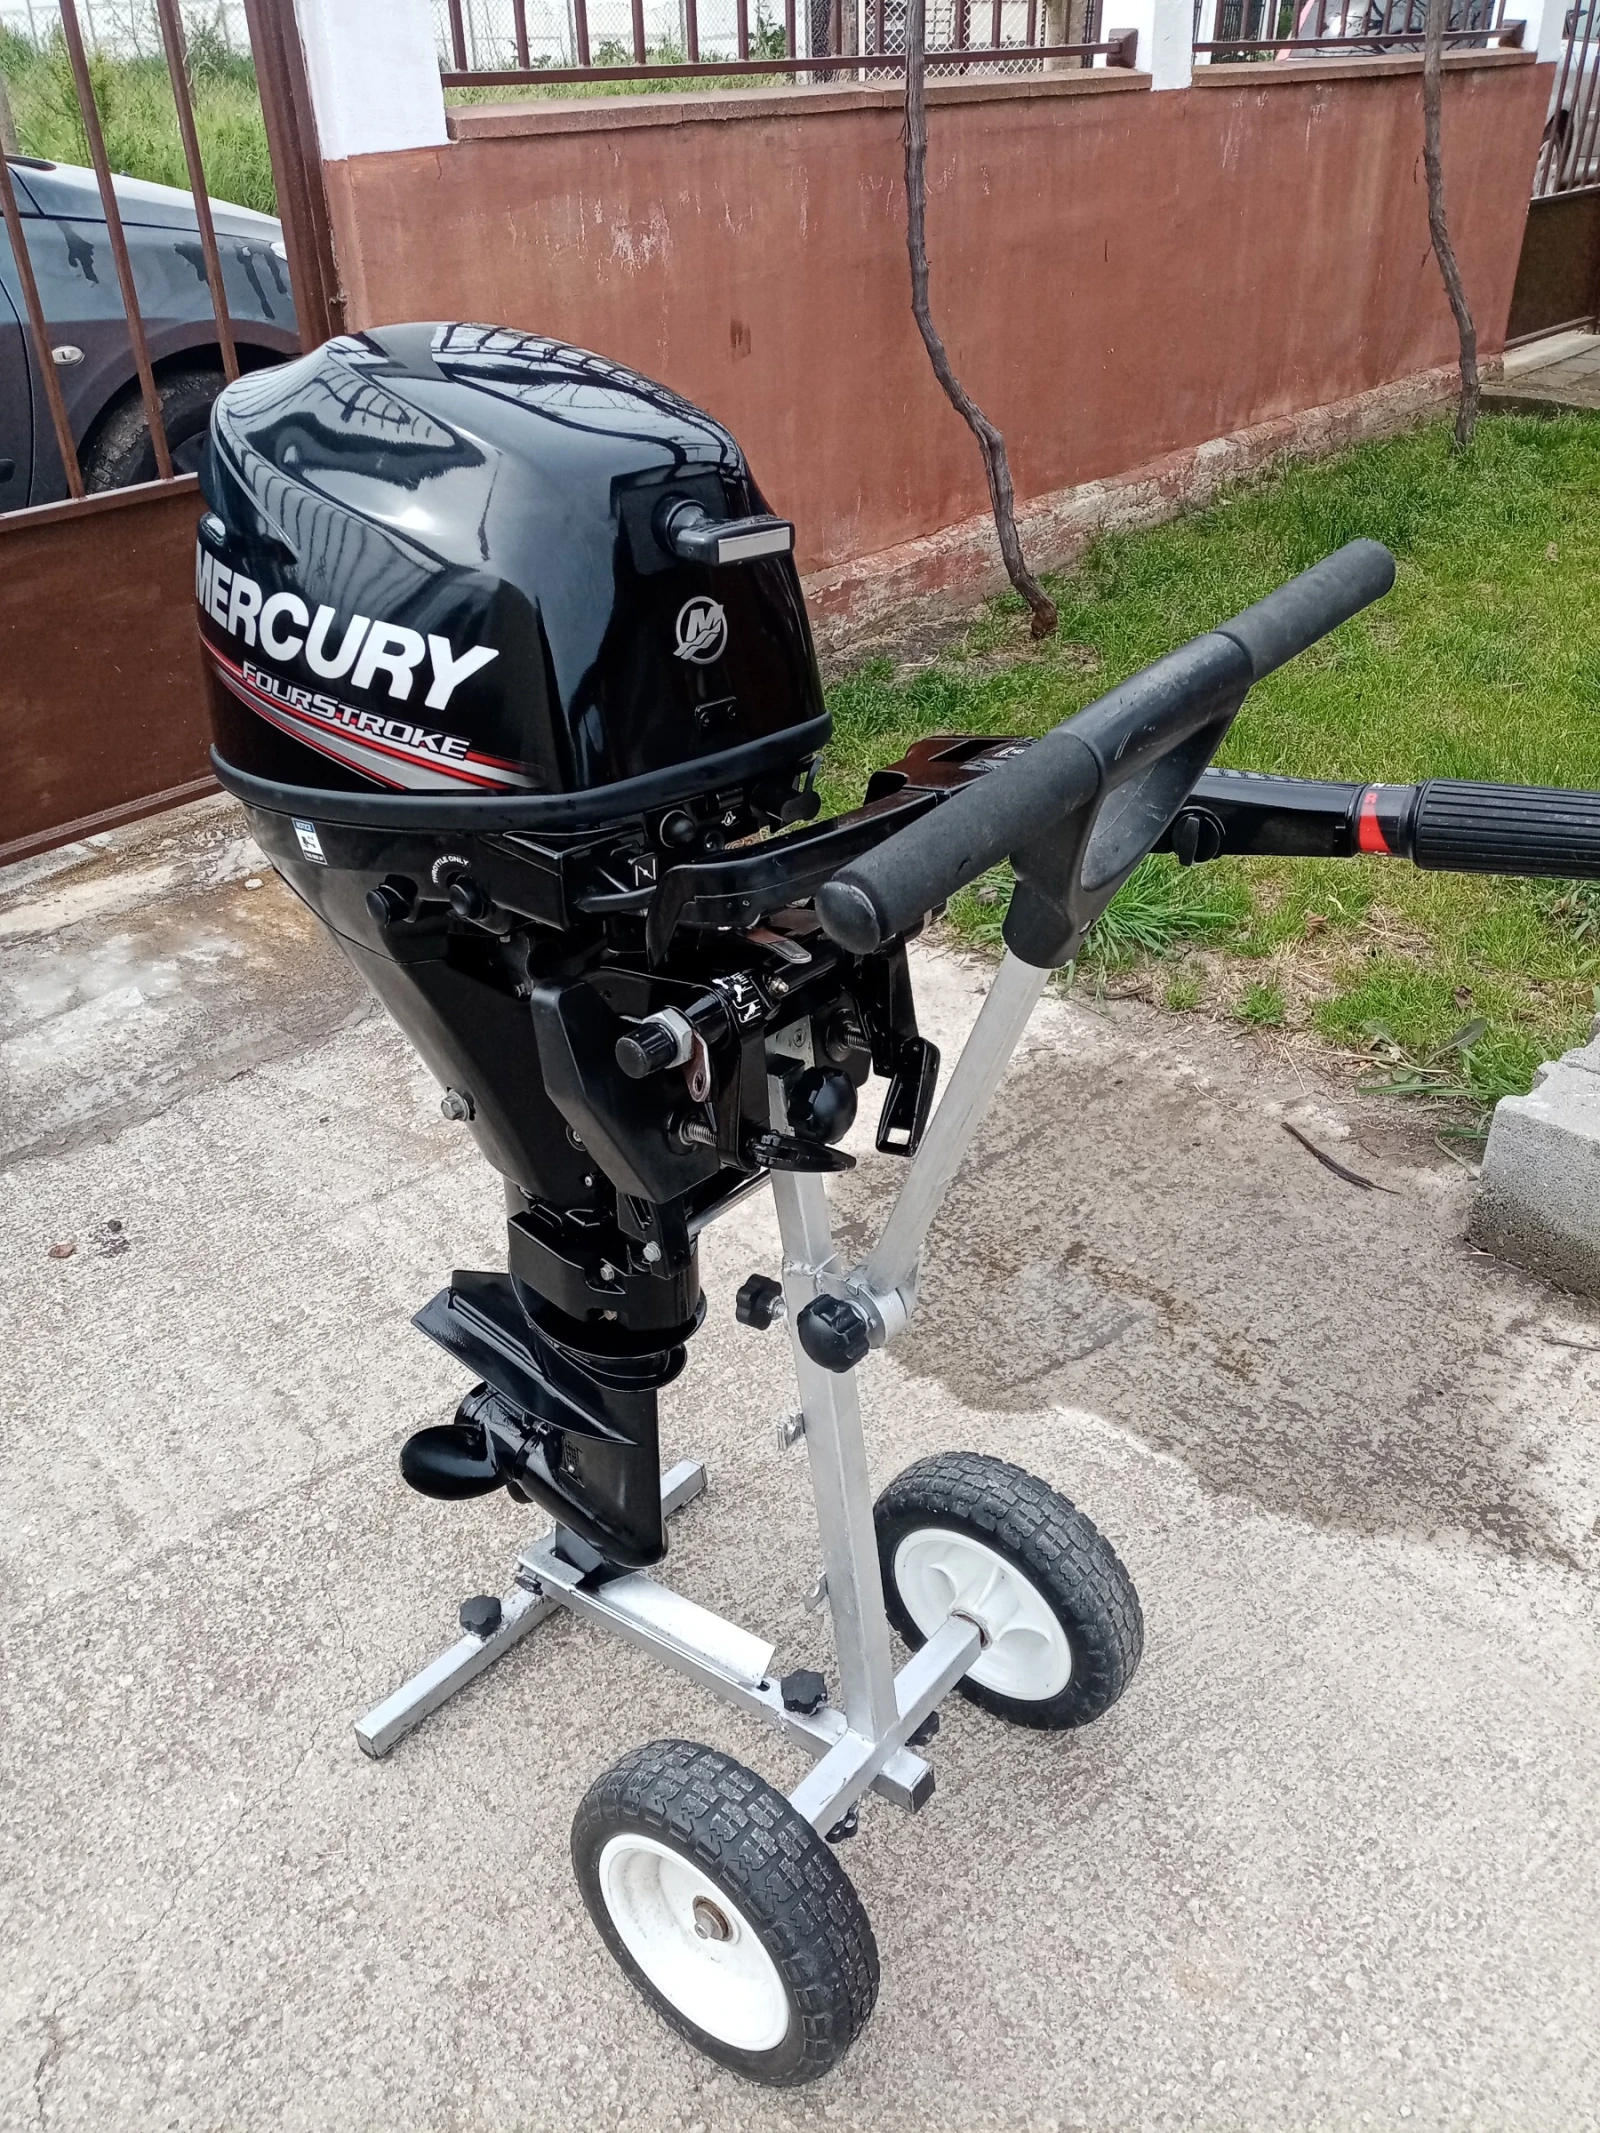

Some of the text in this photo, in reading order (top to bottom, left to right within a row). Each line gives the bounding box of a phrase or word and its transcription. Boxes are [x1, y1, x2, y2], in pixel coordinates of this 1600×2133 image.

[196, 539, 499, 711] MERCURY
[243, 660, 468, 759] FOURSTROKE
[1364, 792, 1378, 804] R
[431, 855, 469, 884] THROTTLE ONLY
